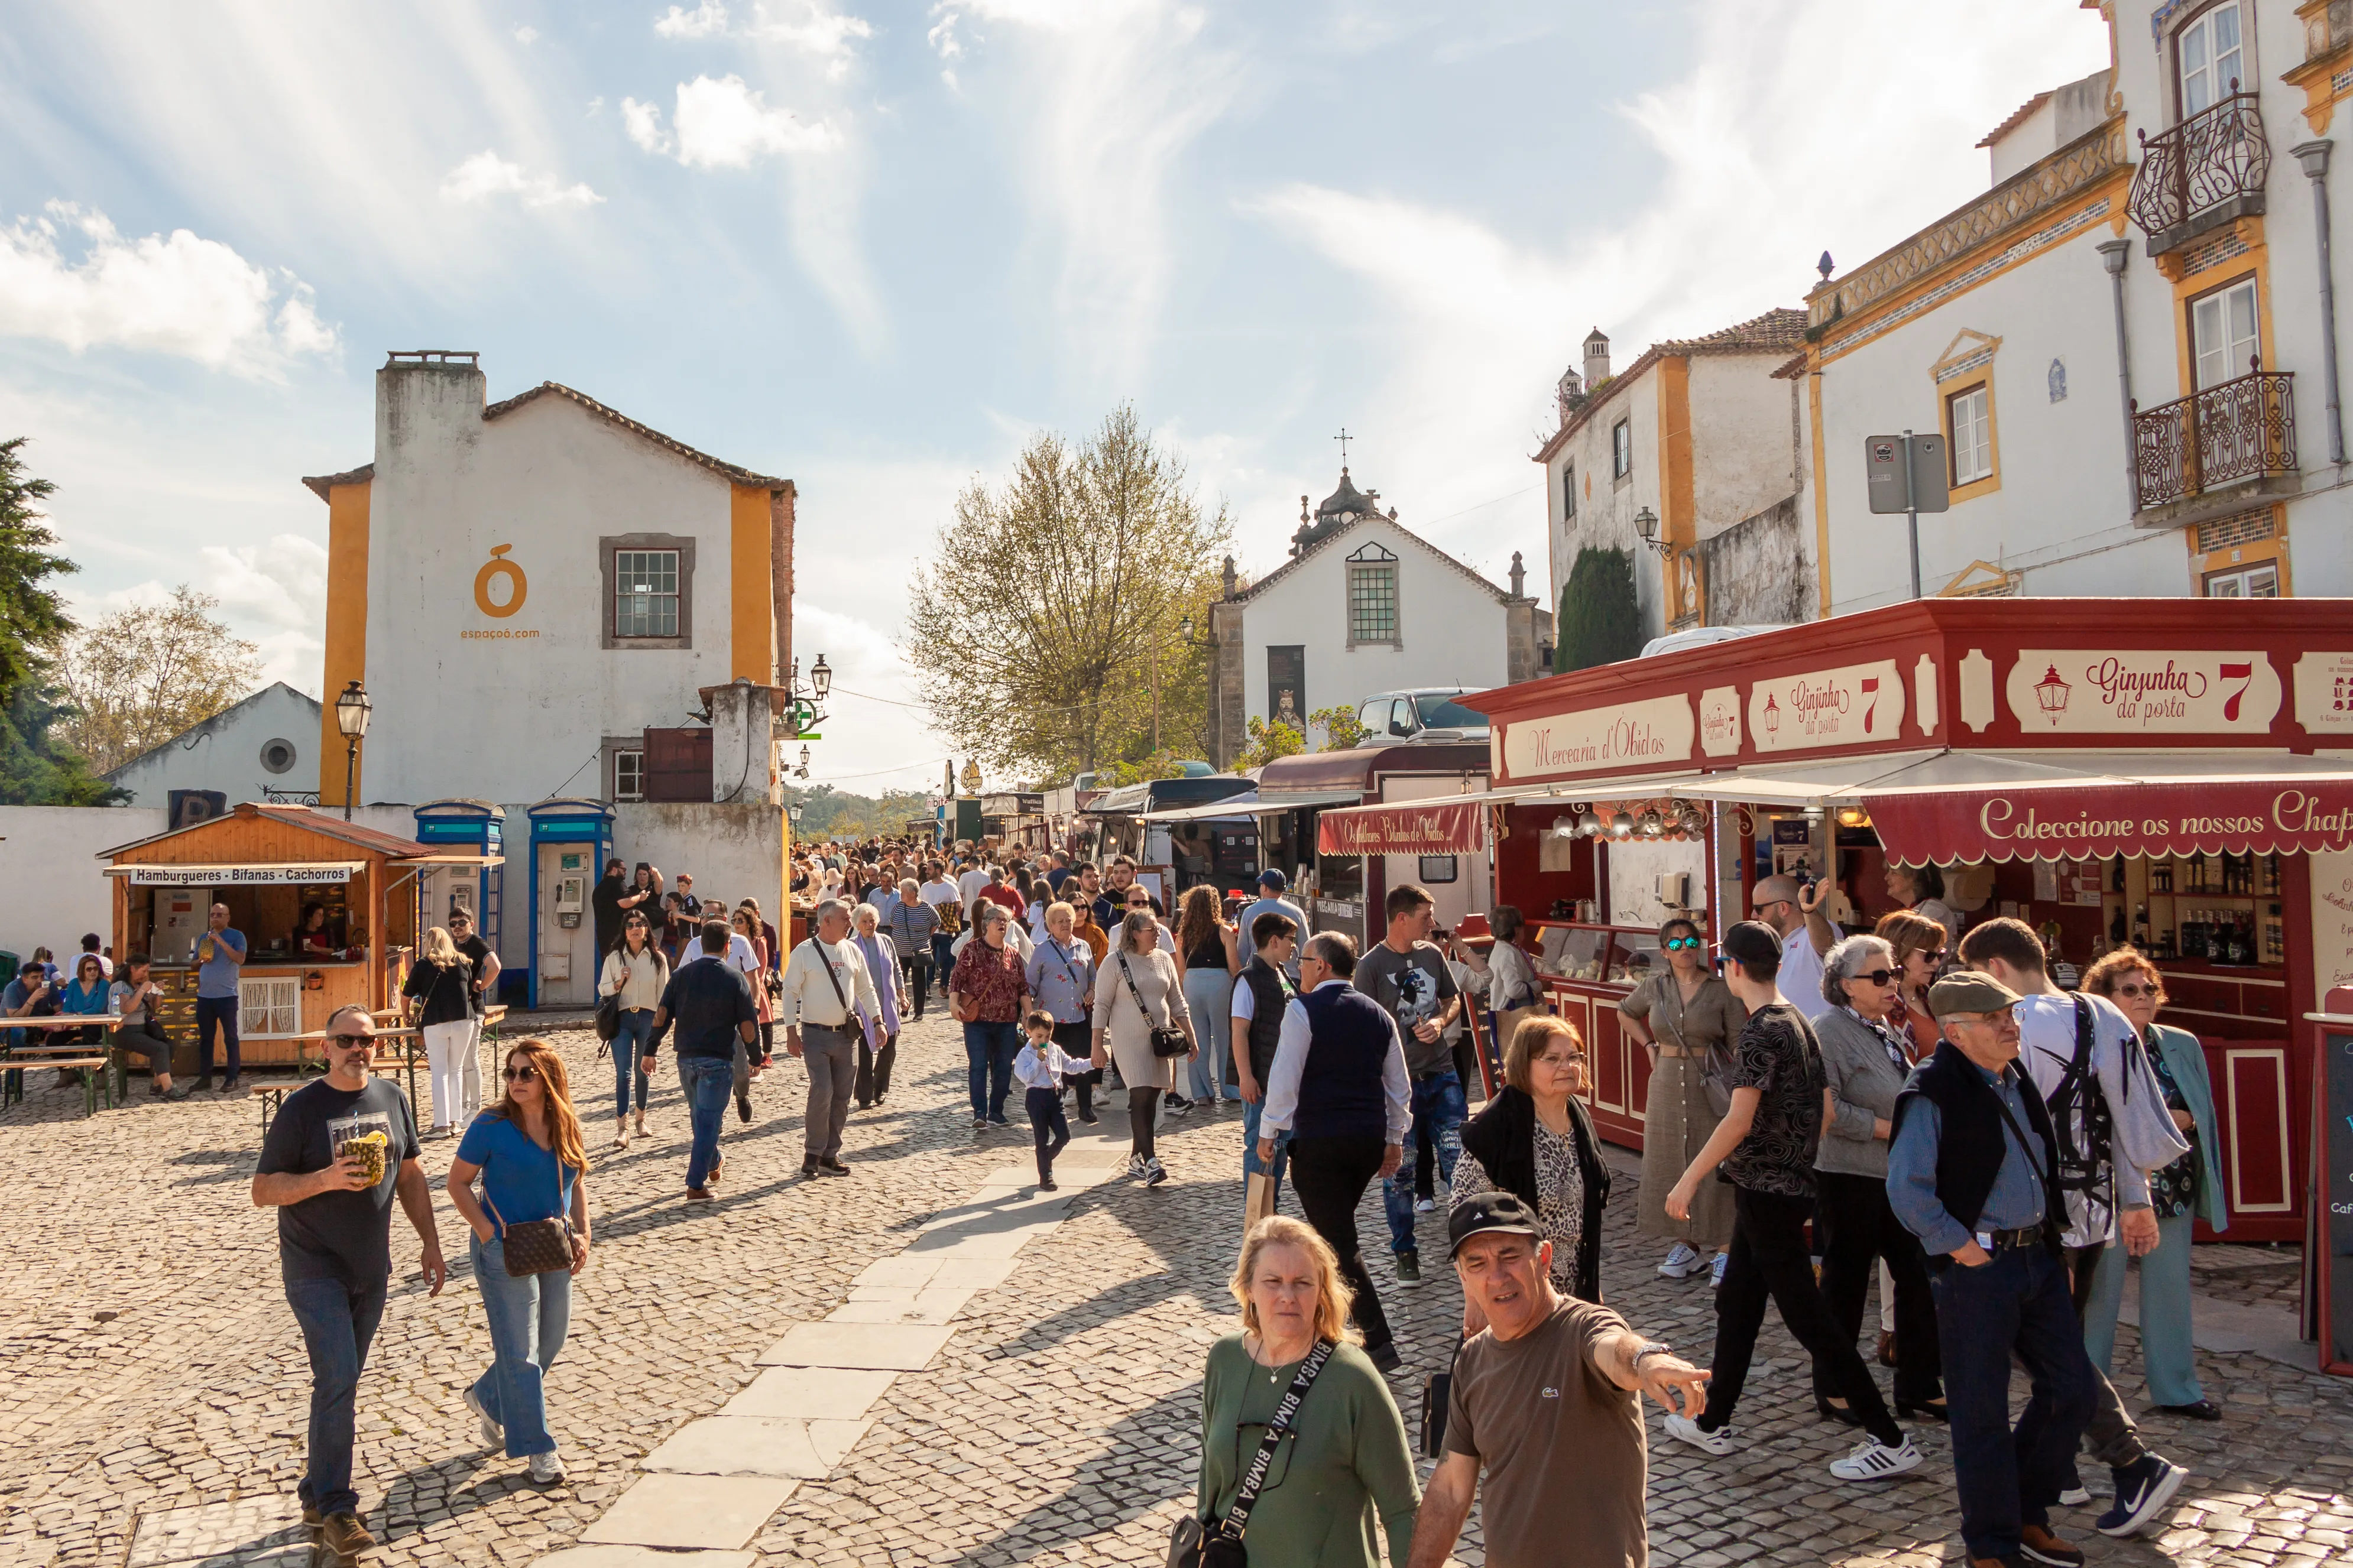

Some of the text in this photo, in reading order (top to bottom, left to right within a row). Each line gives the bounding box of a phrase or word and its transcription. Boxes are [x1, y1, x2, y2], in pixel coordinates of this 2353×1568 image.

[460, 628, 540, 639] espaçoó.com
[1791, 674, 1879, 734] Ginjinha 7
[2117, 692, 2185, 727] da porta
[2219, 661, 2252, 722] 7
[1728, 716, 1735, 737] 7
[1806, 711, 1839, 742] da porta
[1528, 728, 1596, 768] Mercearia
[1980, 798, 2134, 839] Coleccione
[2141, 819, 2170, 836] os
[2180, 816, 2264, 835] nossos
[137, 869, 222, 885] Hamburgueres
[232, 868, 276, 881] Bifanas
[286, 868, 345, 881] Cachorros
[1293, 1341, 1333, 1387] BIMBA
[1239, 1448, 1271, 1499] BIMBA
